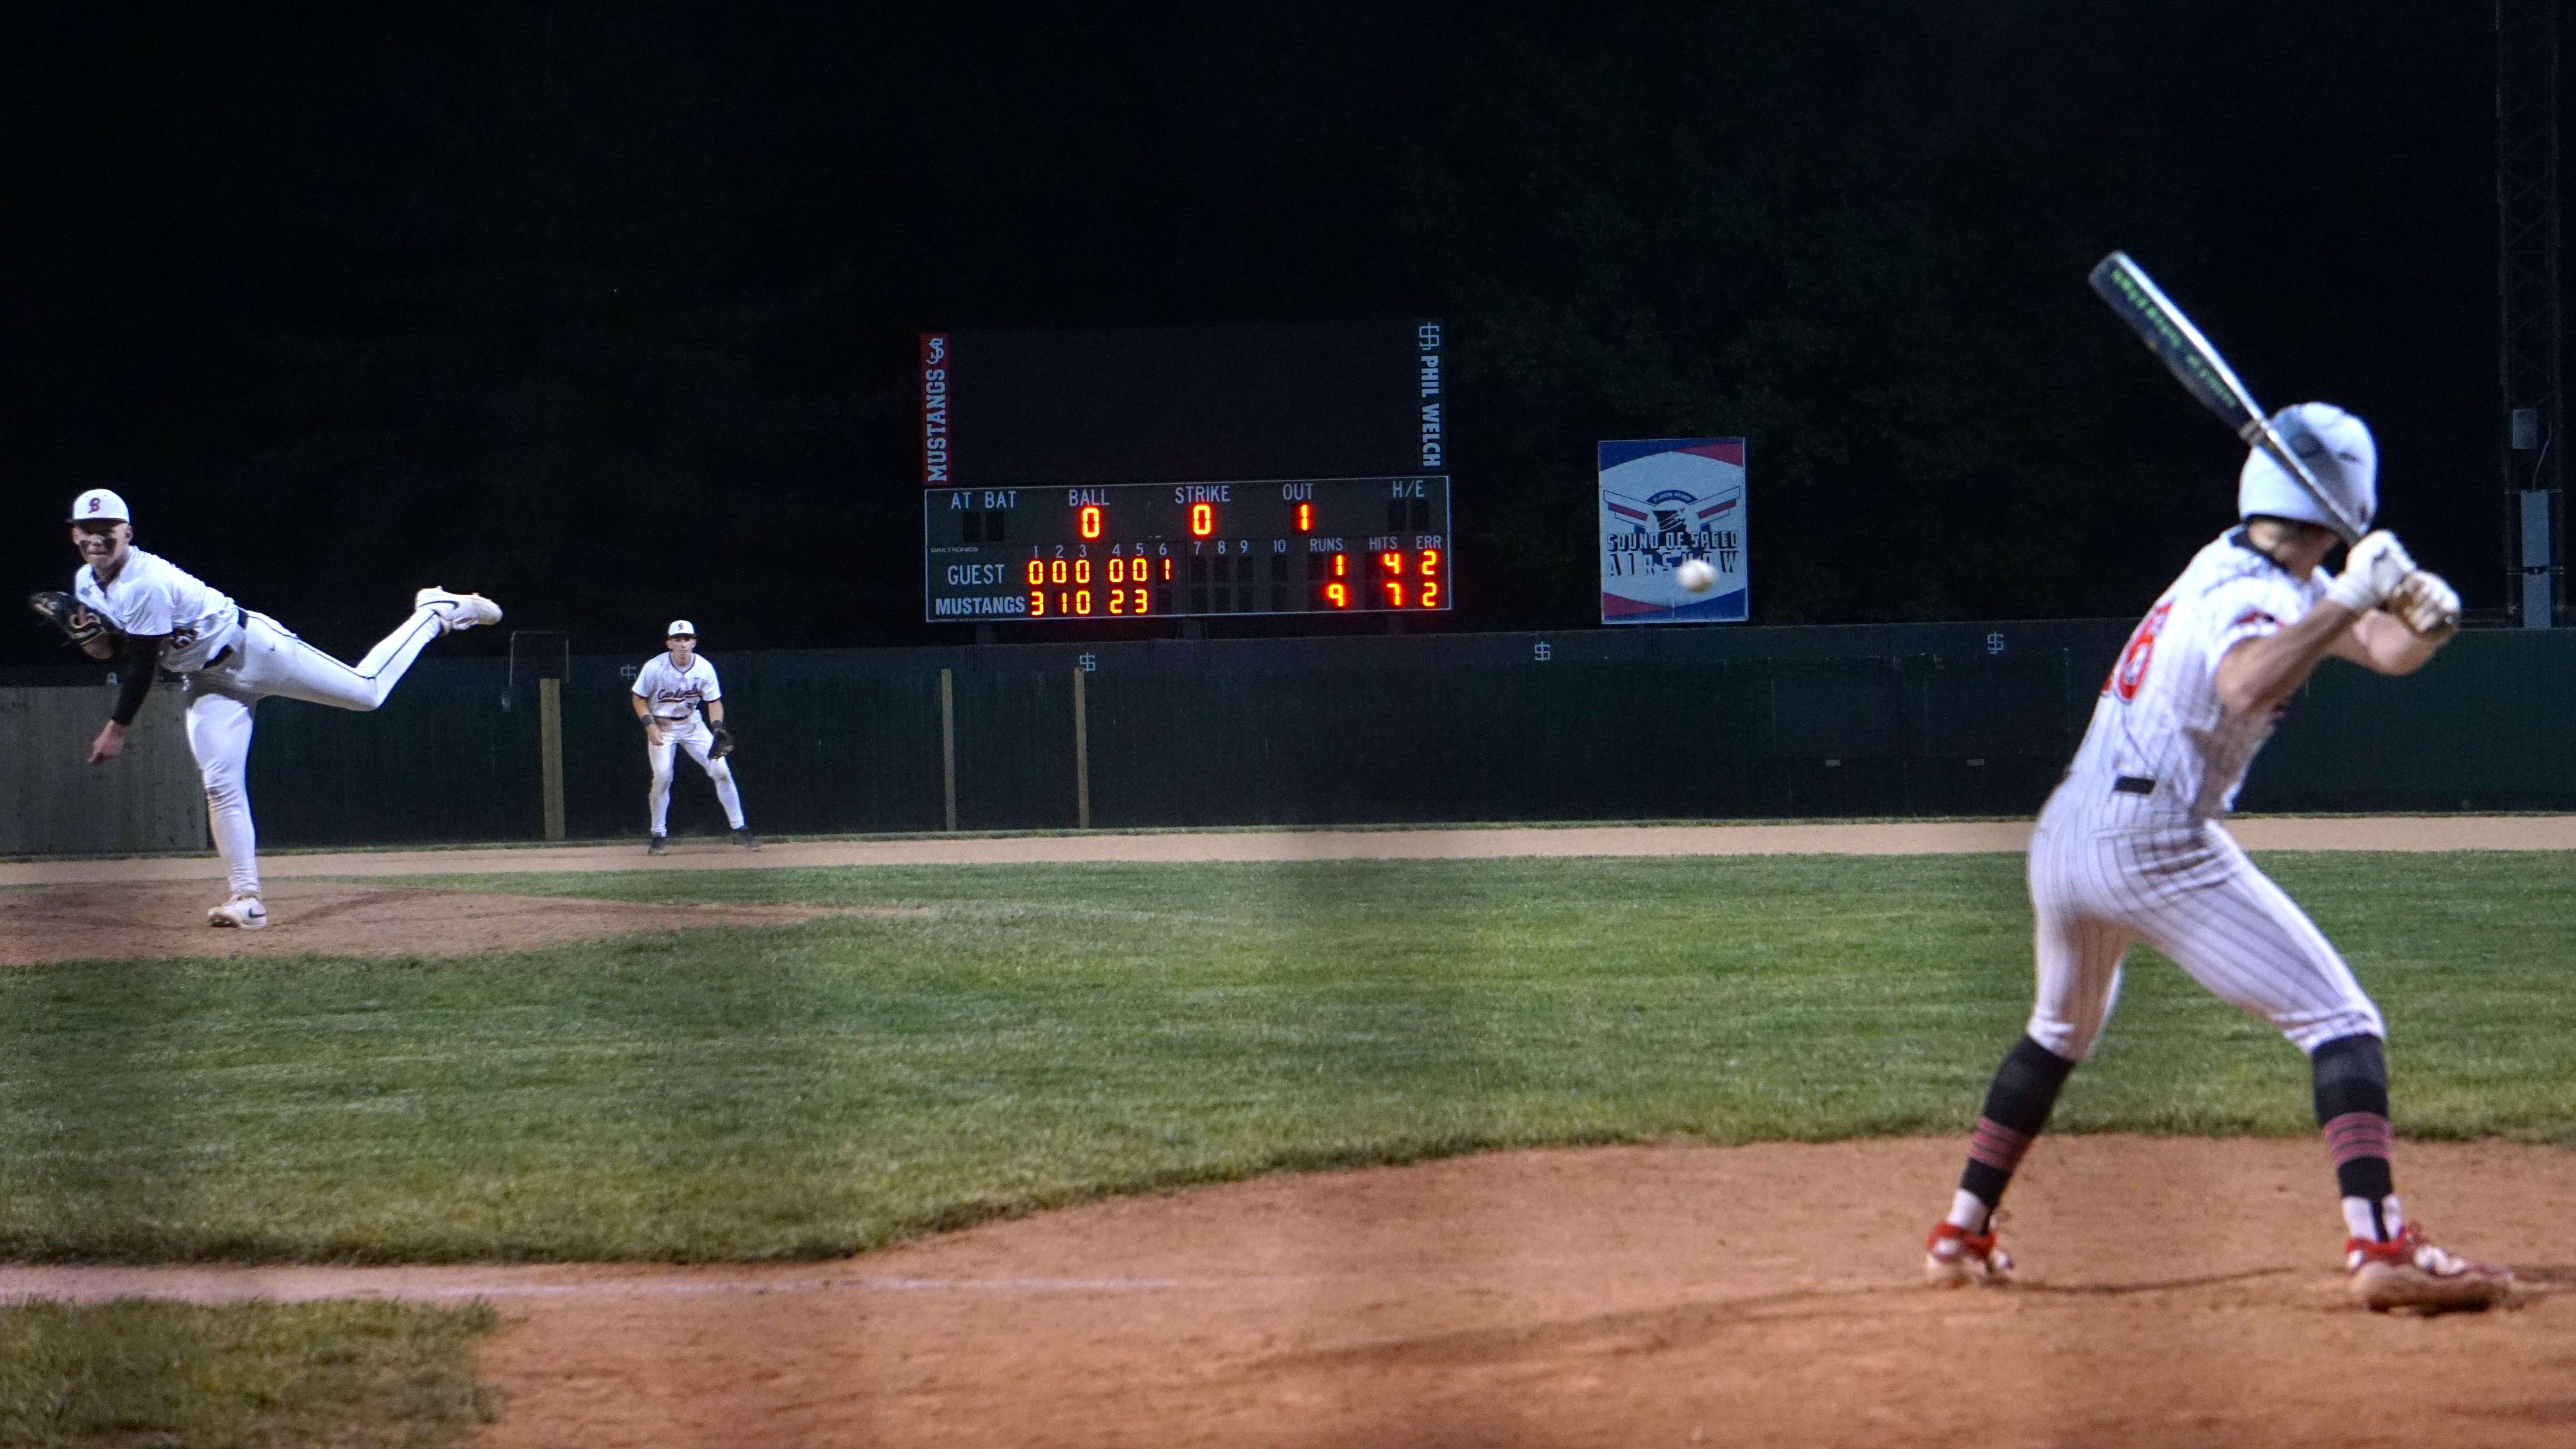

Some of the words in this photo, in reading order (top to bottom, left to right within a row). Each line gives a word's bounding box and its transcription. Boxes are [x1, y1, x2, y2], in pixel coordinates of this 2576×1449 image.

[1421, 355, 1439, 398] PHIL
[925, 369, 947, 482] MUSTANGS
[1422, 403, 1441, 466] WELCH
[951, 492, 971, 509] AT
[985, 491, 1016, 509] BAT
[1069, 489, 1110, 507] BALL
[1174, 485, 1230, 504] STRIKE
[1283, 483, 1314, 500] OUT
[1393, 480, 1424, 498] H/E
[1082, 507, 1100, 538] 0
[1193, 505, 1211, 535] 0
[1301, 504, 1308, 530] 1
[1033, 545, 1038, 558] 1
[1056, 545, 1064, 558] 2
[1079, 544, 1087, 557] 3
[1112, 543, 1120, 557] 4
[1136, 543, 1144, 556] 5
[1159, 543, 1167, 556] 6
[1194, 542, 1201, 555] 7
[1217, 541, 1226, 554] 8
[1240, 540, 1248, 554] 9
[1274, 539, 1286, 553] 10
[1310, 538, 1343, 552] RUNS
[1369, 536, 1398, 550] HITS
[1416, 535, 1441, 549] ERR
[1607, 531, 1658, 552] SOUND
[1666, 532, 1684, 550] OF
[1690, 530, 1738, 549] SPEED
[947, 564, 1005, 585] GUEST
[1029, 561, 1044, 585] 0
[1052, 560, 1067, 583] 0
[1075, 560, 1090, 583] 0
[1109, 559, 1124, 582] 0
[1132, 558, 1147, 582] 0
[1165, 558, 1170, 580] 1
[1336, 555, 1343, 576] 1
[1384, 553, 1400, 574] 4
[1421, 551, 1436, 575] 2
[935, 596, 1025, 615] MUSTANGS
[1031, 591, 1044, 615] 3
[1061, 592, 1067, 614] 1
[1076, 591, 1091, 614] 0
[1110, 590, 1124, 614] 2
[1134, 589, 1148, 613] 3
[1328, 584, 1344, 607] 9
[1387, 583, 1400, 606] 7
[1422, 582, 1436, 606] 2
